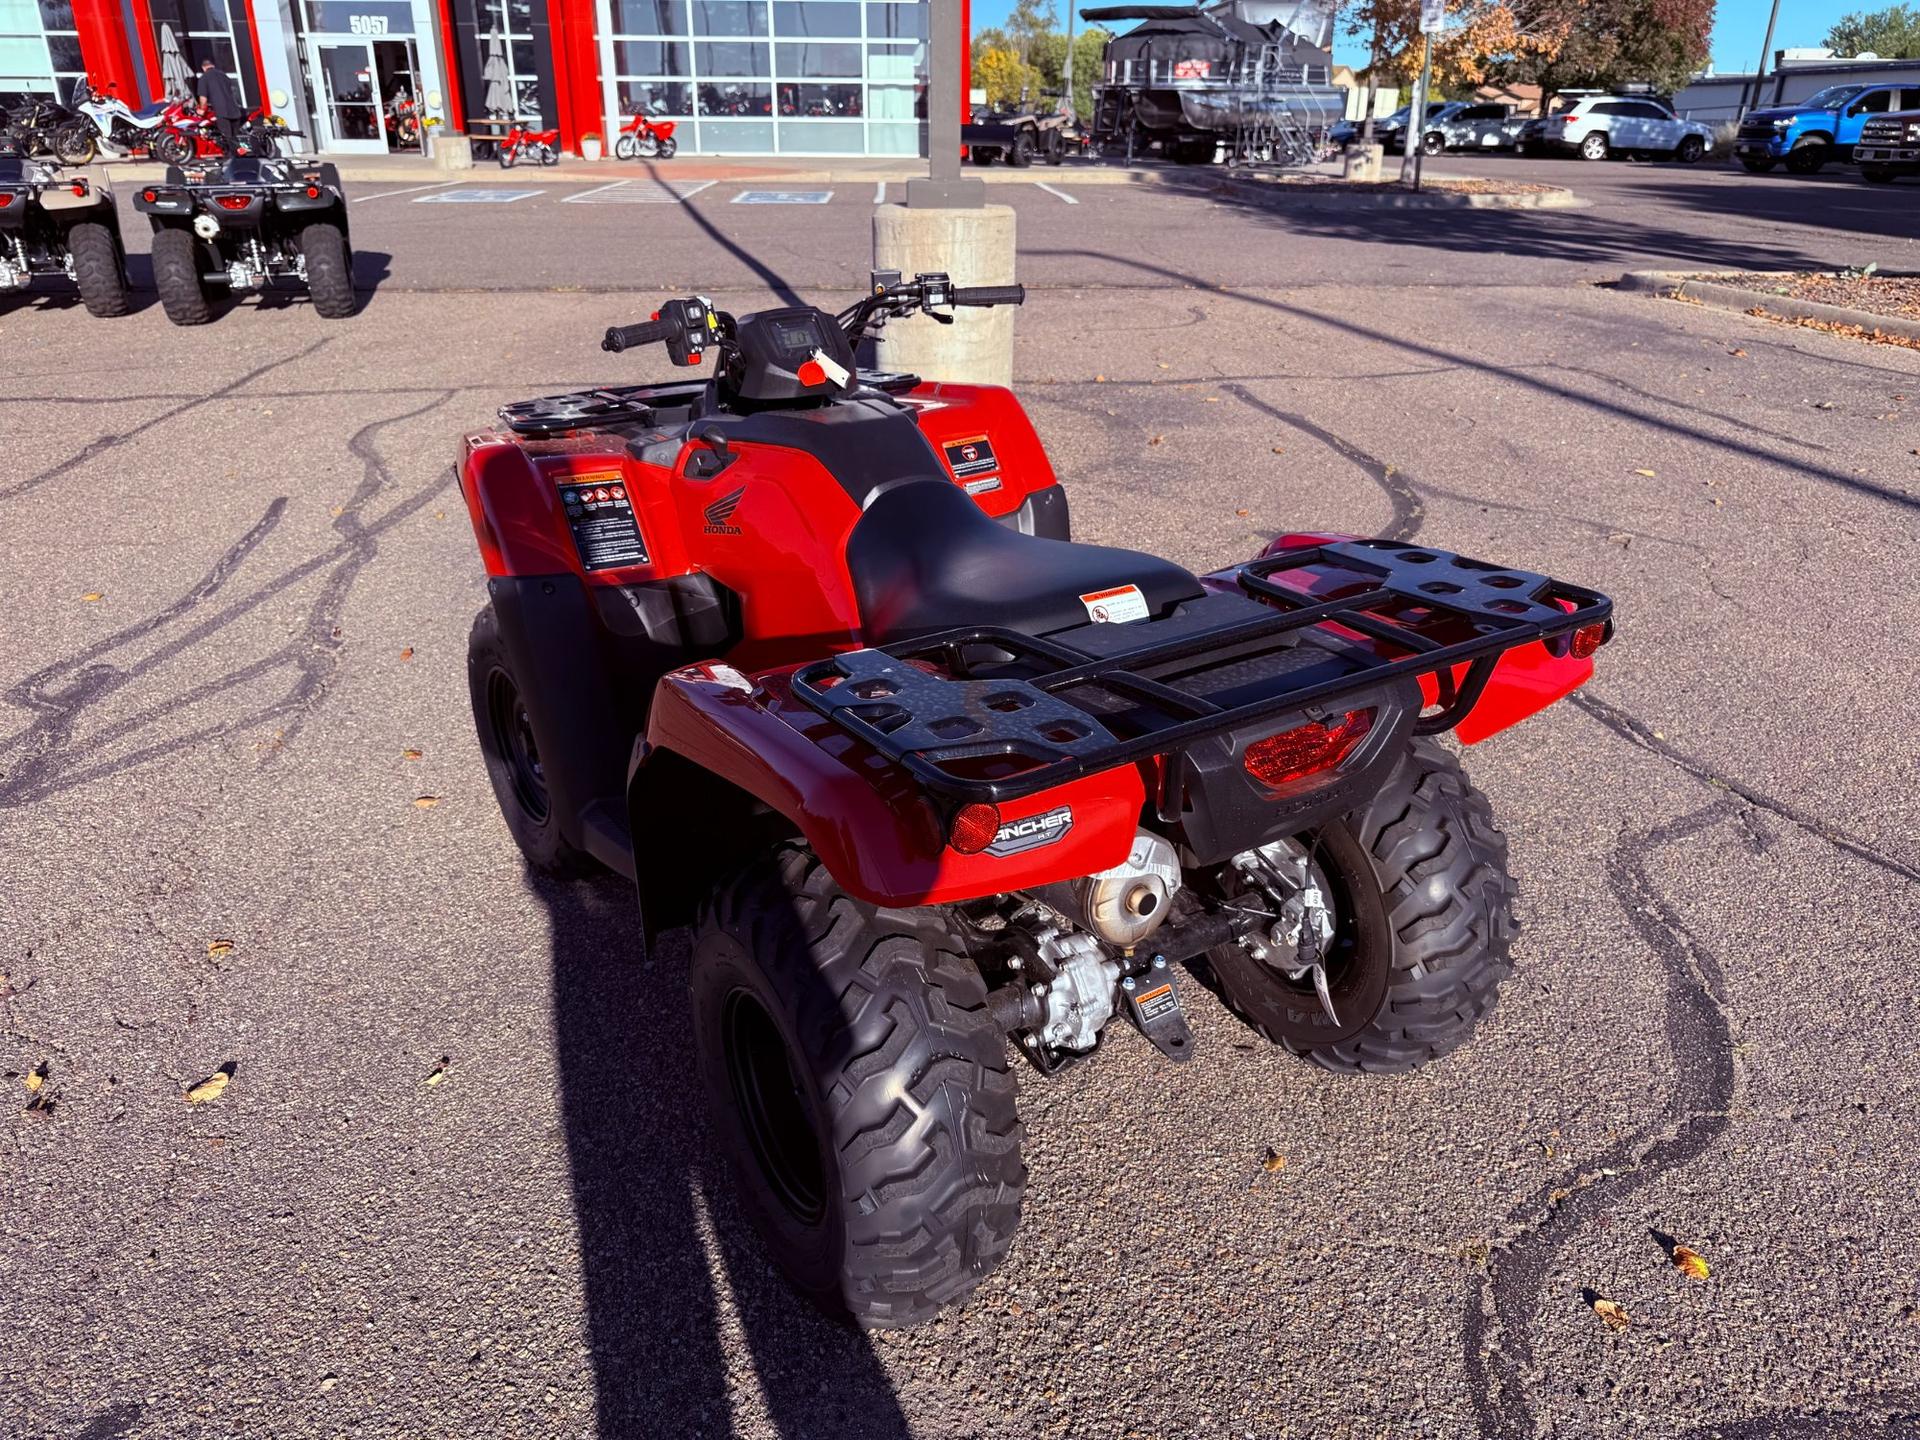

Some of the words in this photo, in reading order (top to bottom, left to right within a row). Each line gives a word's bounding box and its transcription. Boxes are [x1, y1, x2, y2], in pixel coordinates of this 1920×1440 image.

[349, 14, 389, 34] 5057
[703, 525, 743, 535] HONDA
[992, 811, 1072, 843] ANCHER
